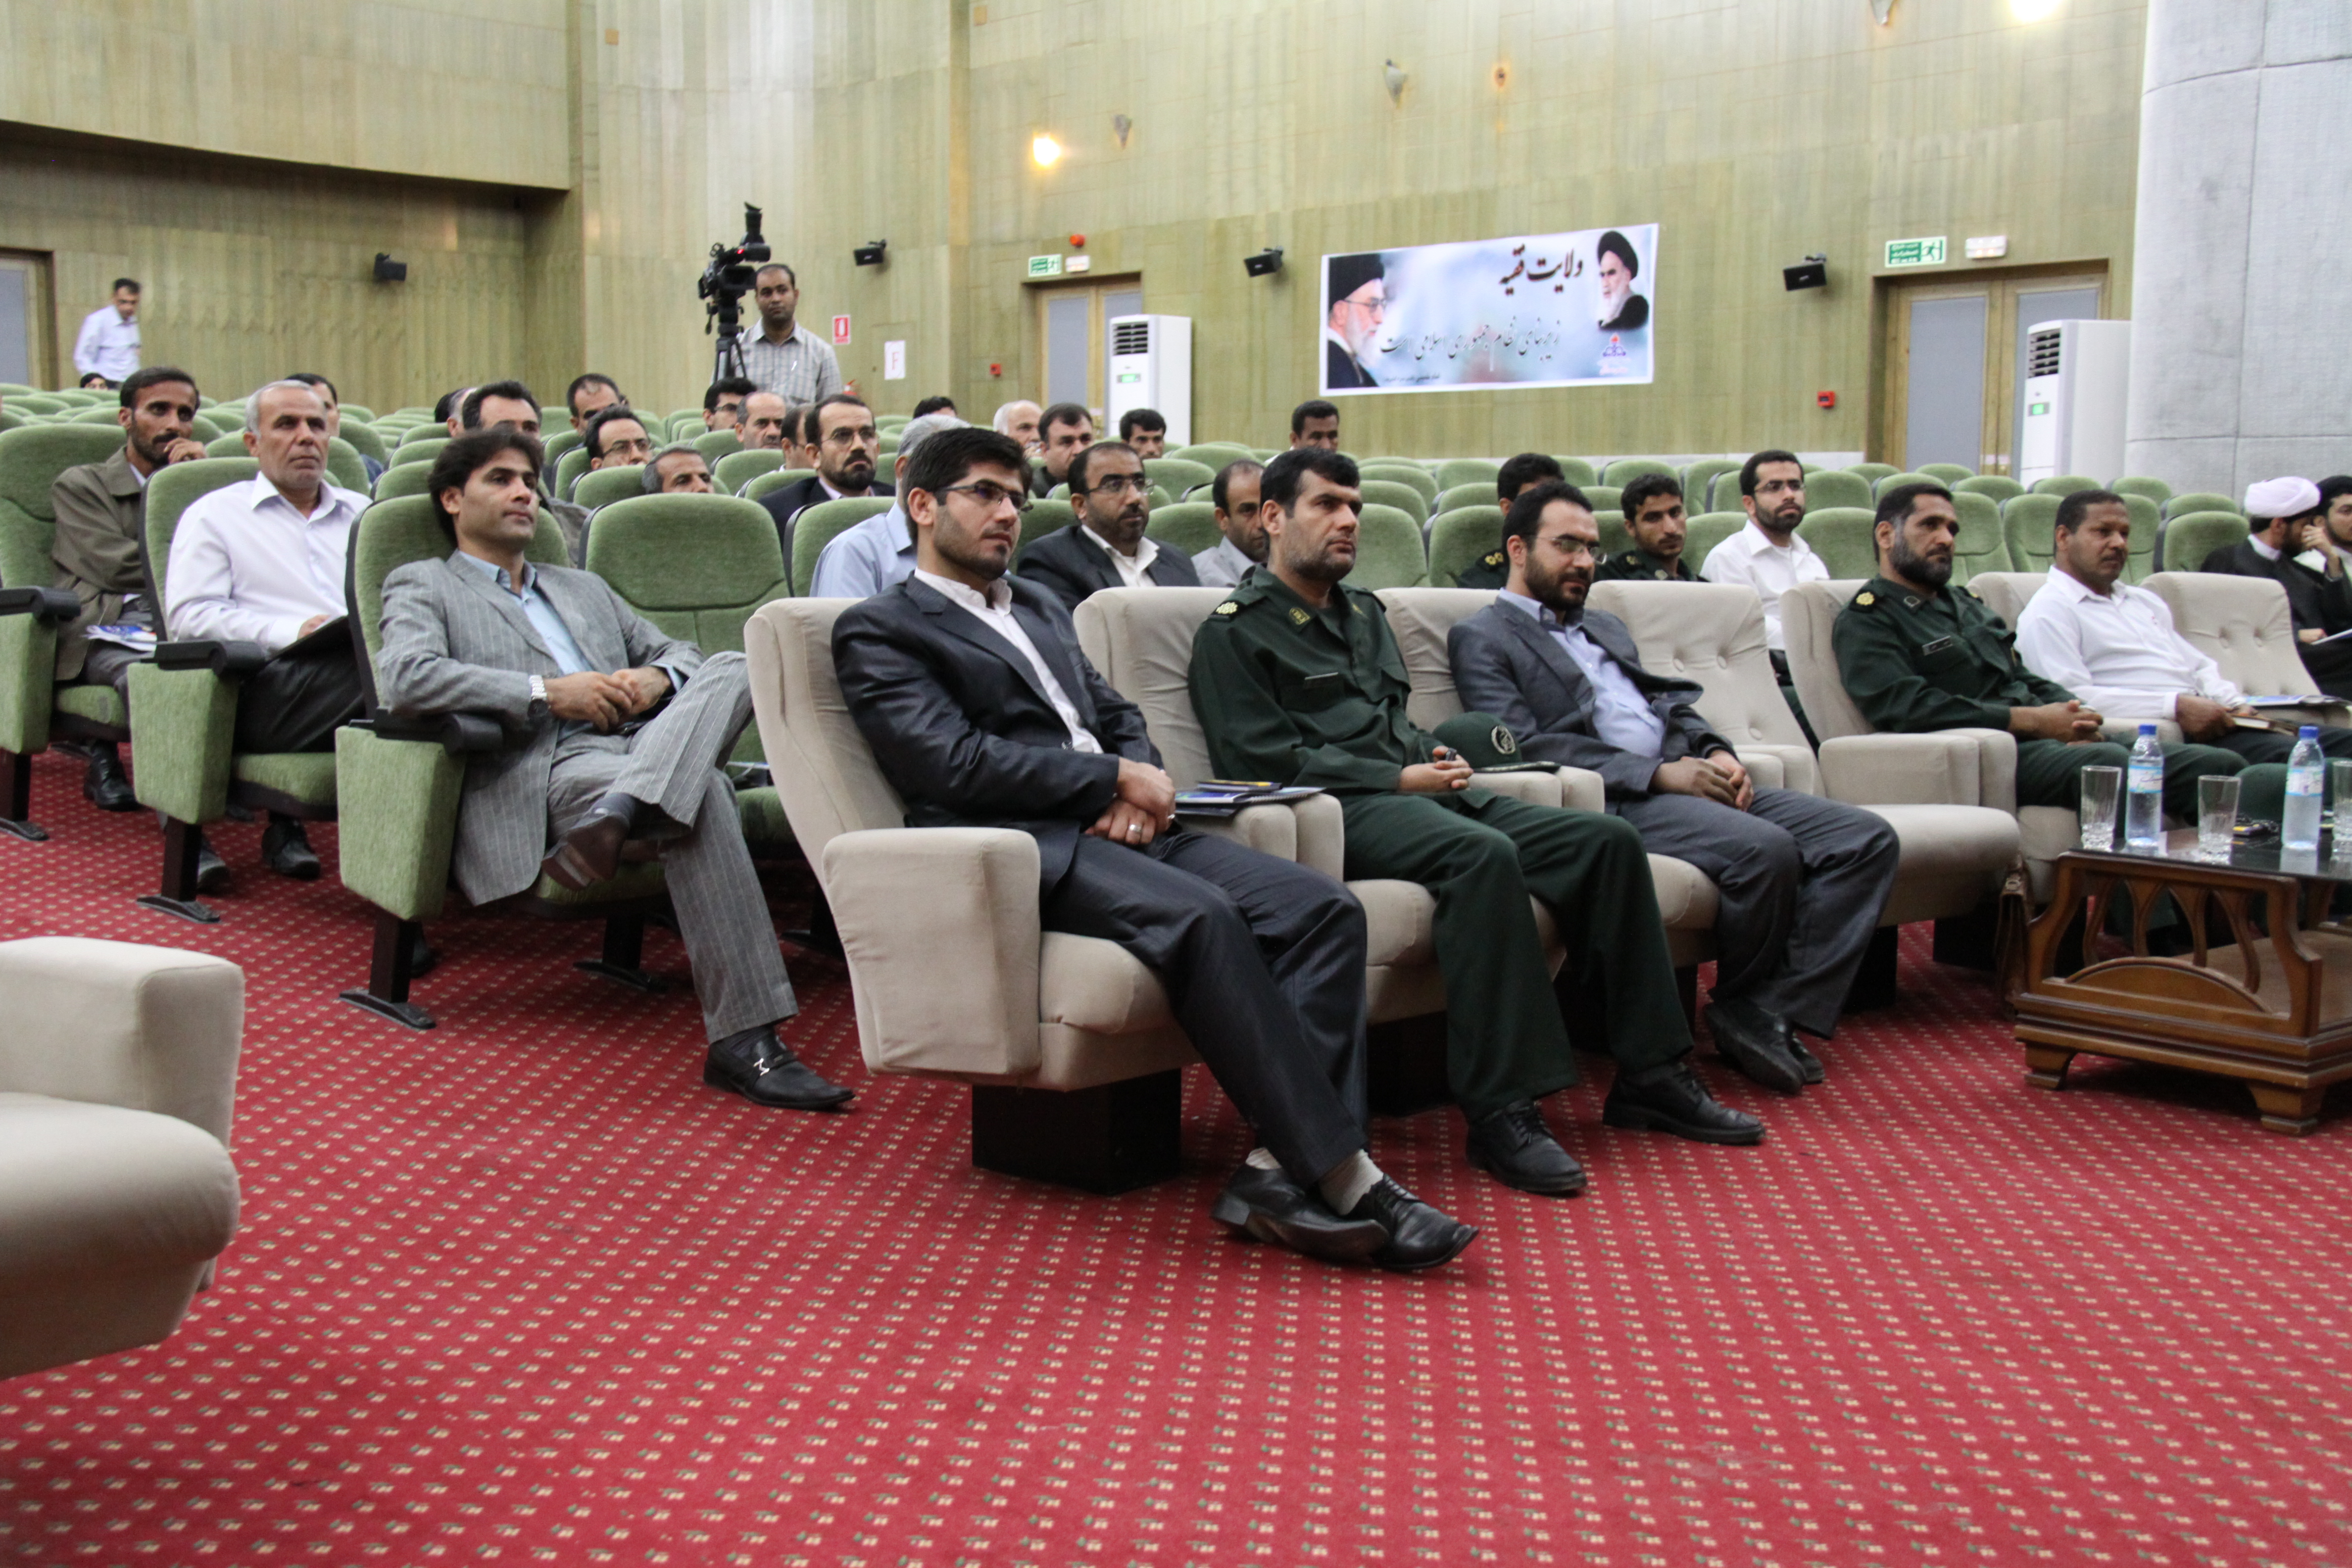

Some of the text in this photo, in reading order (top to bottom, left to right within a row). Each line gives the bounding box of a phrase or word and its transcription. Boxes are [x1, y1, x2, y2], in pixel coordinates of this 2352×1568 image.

[1499, 243, 1583, 295] ولایت فقیه
[1380, 335, 1411, 353] است
[1415, 331, 1446, 361] اسلامی
[1448, 324, 1489, 359] جمهوری
[1490, 315, 1517, 372] نظام
